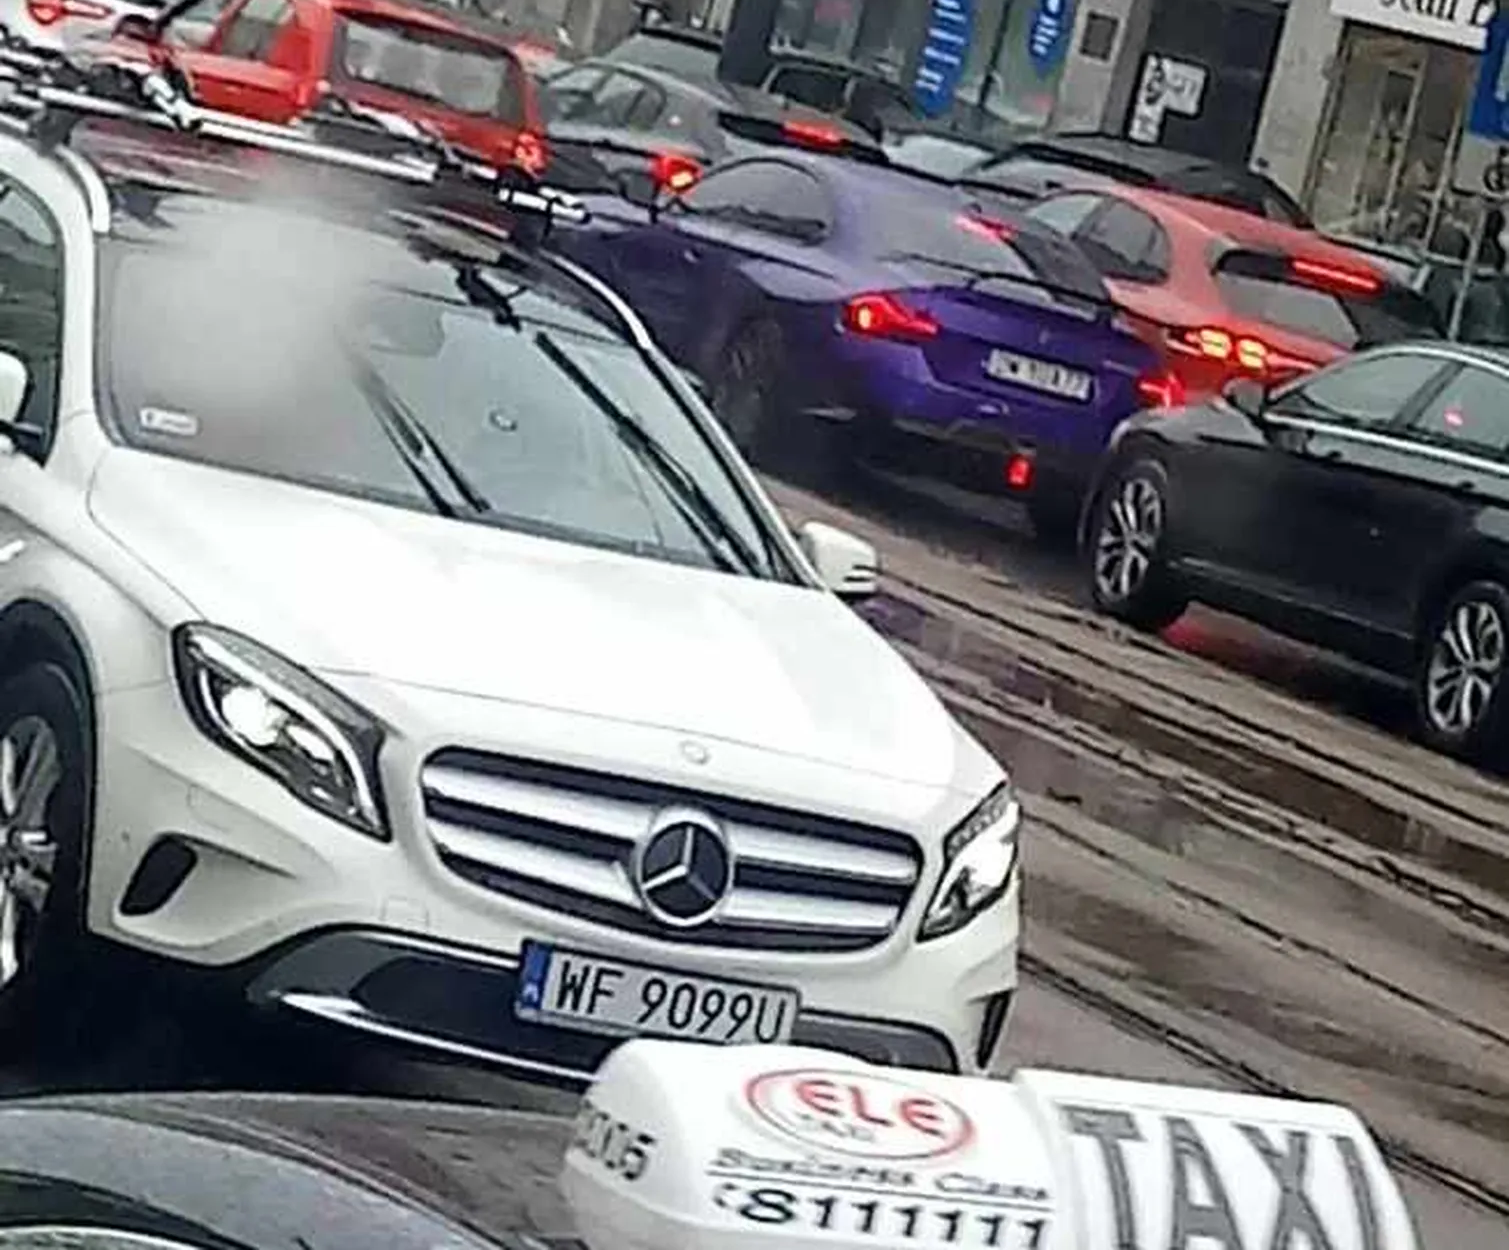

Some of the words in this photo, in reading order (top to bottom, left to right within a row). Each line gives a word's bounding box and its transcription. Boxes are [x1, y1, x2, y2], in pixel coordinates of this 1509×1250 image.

[556, 960, 624, 1014] WF
[638, 978, 788, 1043] 9099U
[795, 1080, 945, 1137] ELE
[1055, 1105, 1380, 1250] TAXI
